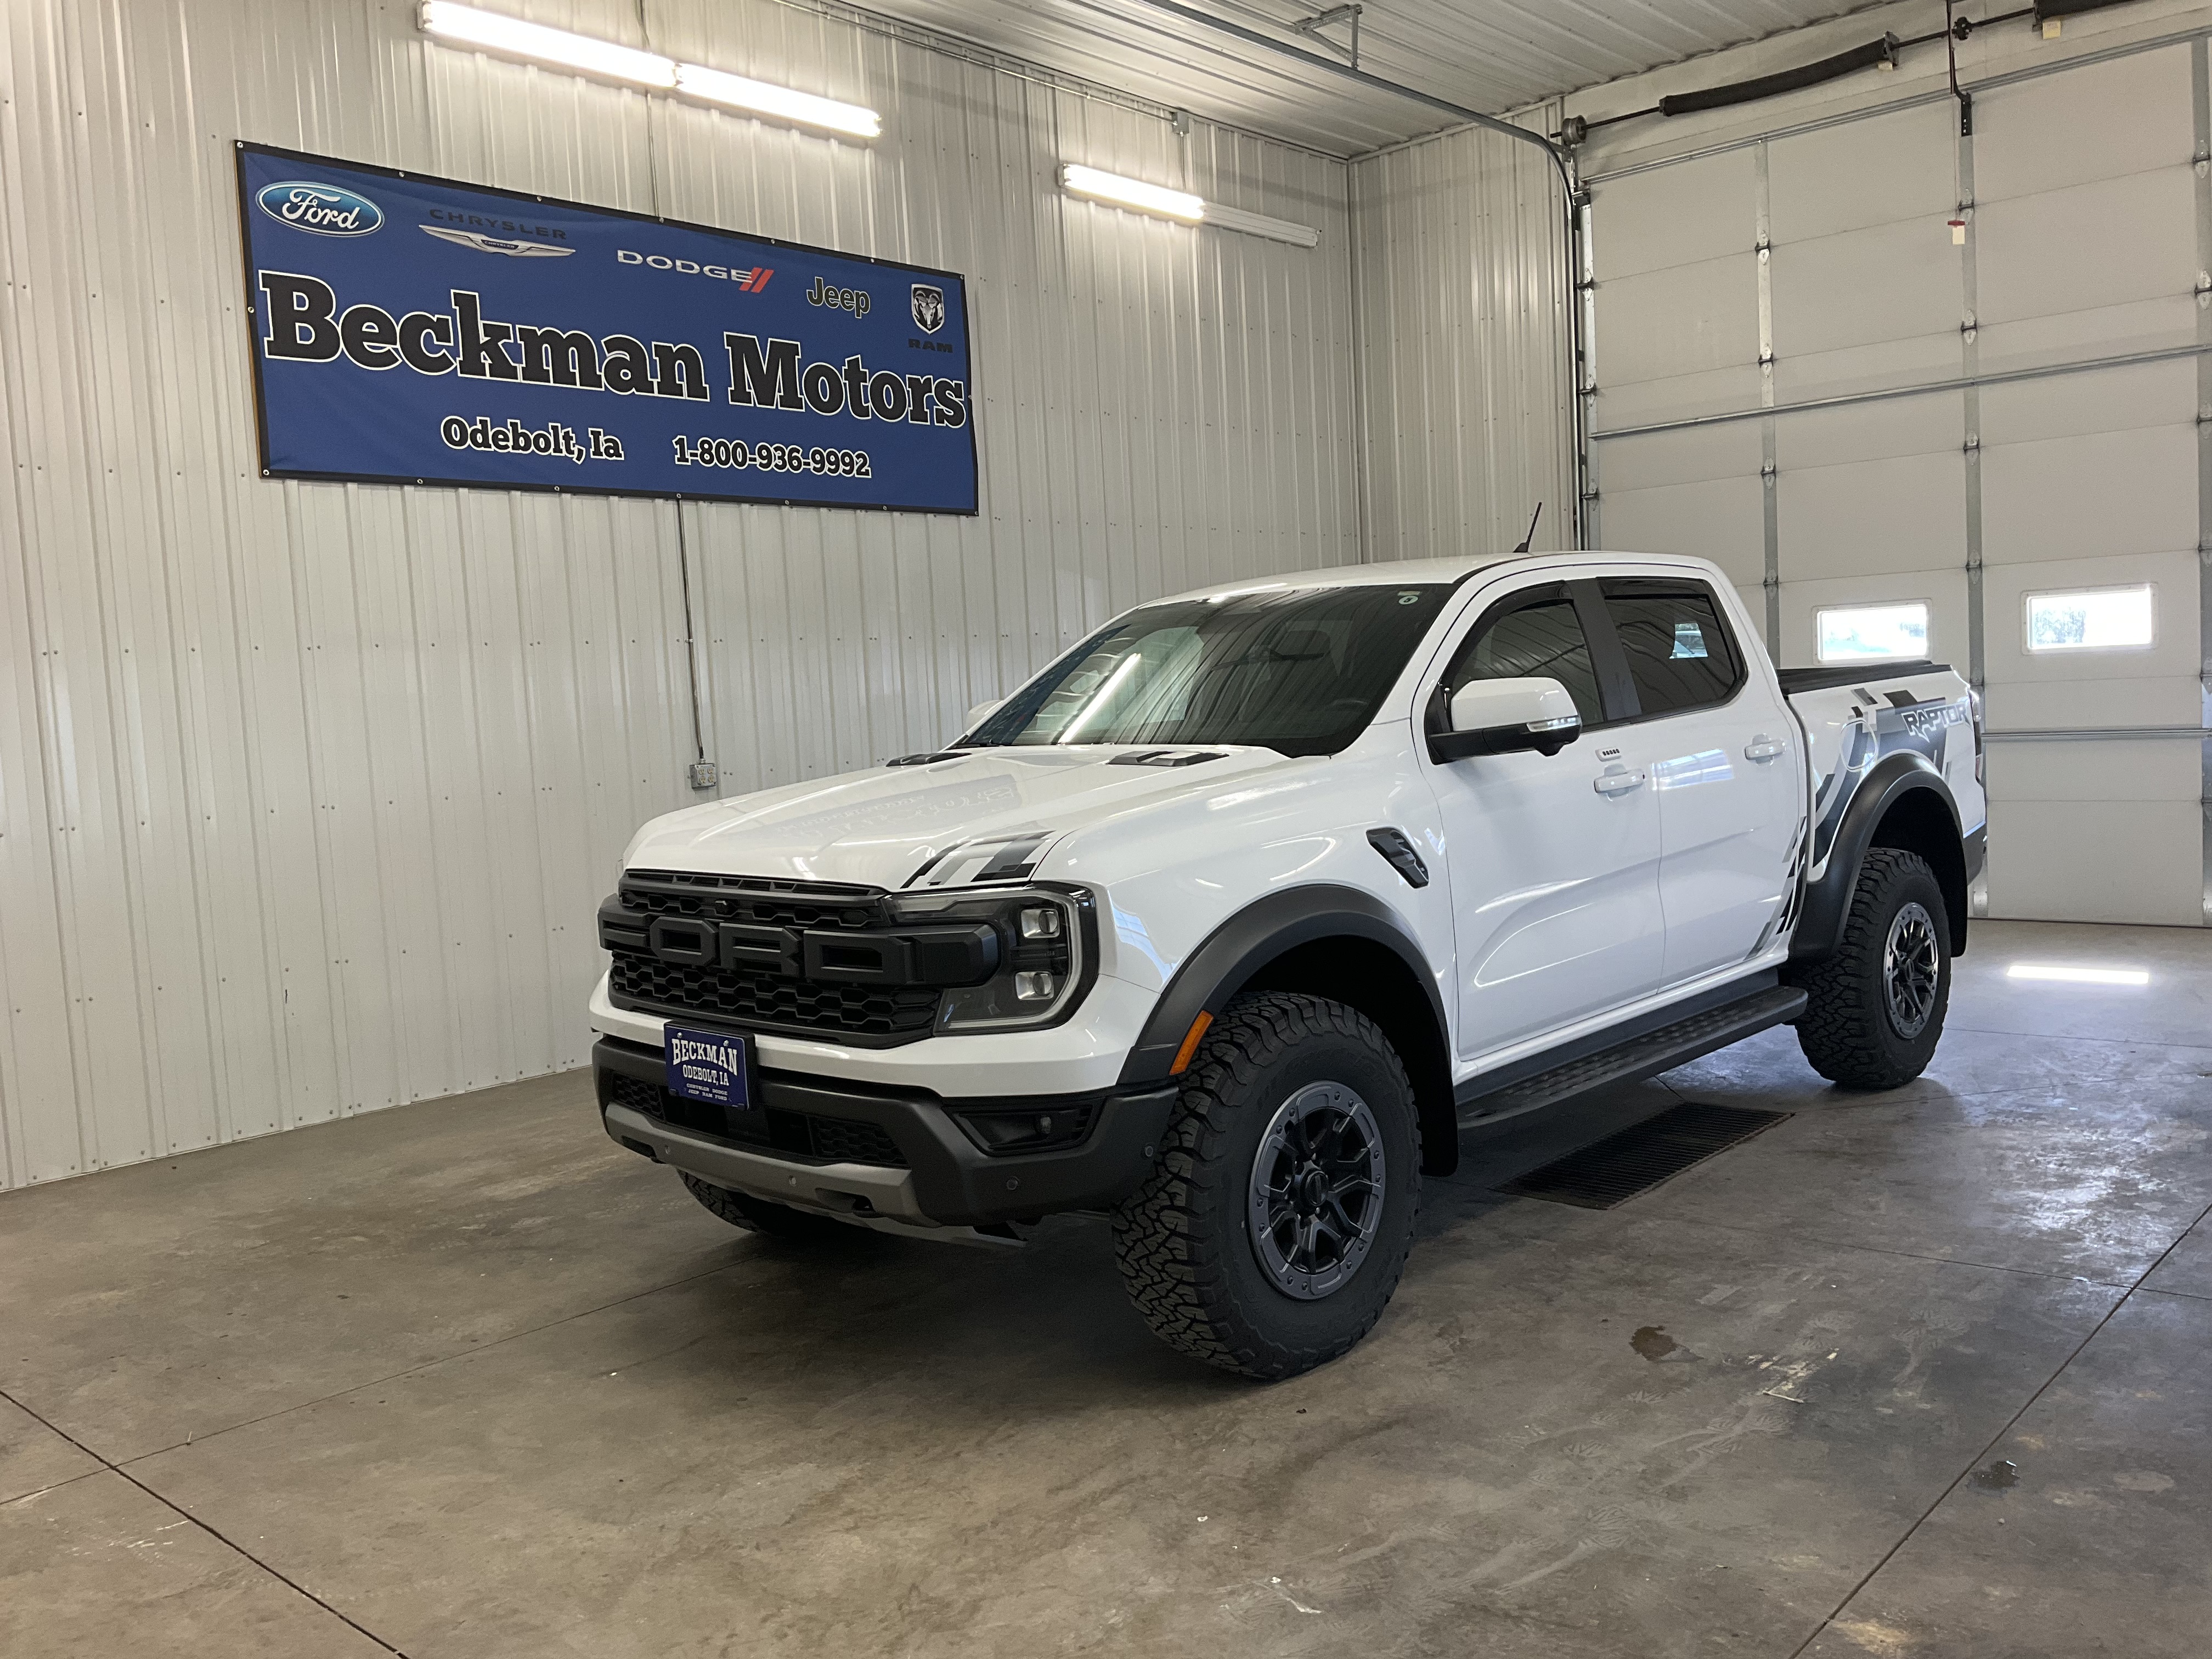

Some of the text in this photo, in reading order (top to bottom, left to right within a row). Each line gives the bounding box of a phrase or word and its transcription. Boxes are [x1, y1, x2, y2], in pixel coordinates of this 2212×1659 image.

[282, 189, 359, 230] Ford
[430, 208, 566, 240] CHRYSLER
[617, 250, 753, 284] DODGE
[806, 276, 871, 319] Jeep
[258, 269, 966, 428] Beckman Motors
[909, 338, 953, 353] RAM
[441, 415, 624, 464] Odebolt, Ia
[672, 435, 871, 478] 1-800-936-9992
[1901, 702, 1972, 743] RAPTOR
[599, 908, 911, 984] FORD
[672, 1038, 737, 1076] BECKMAN
[682, 1064, 729, 1086] ODEBOLT, IA
